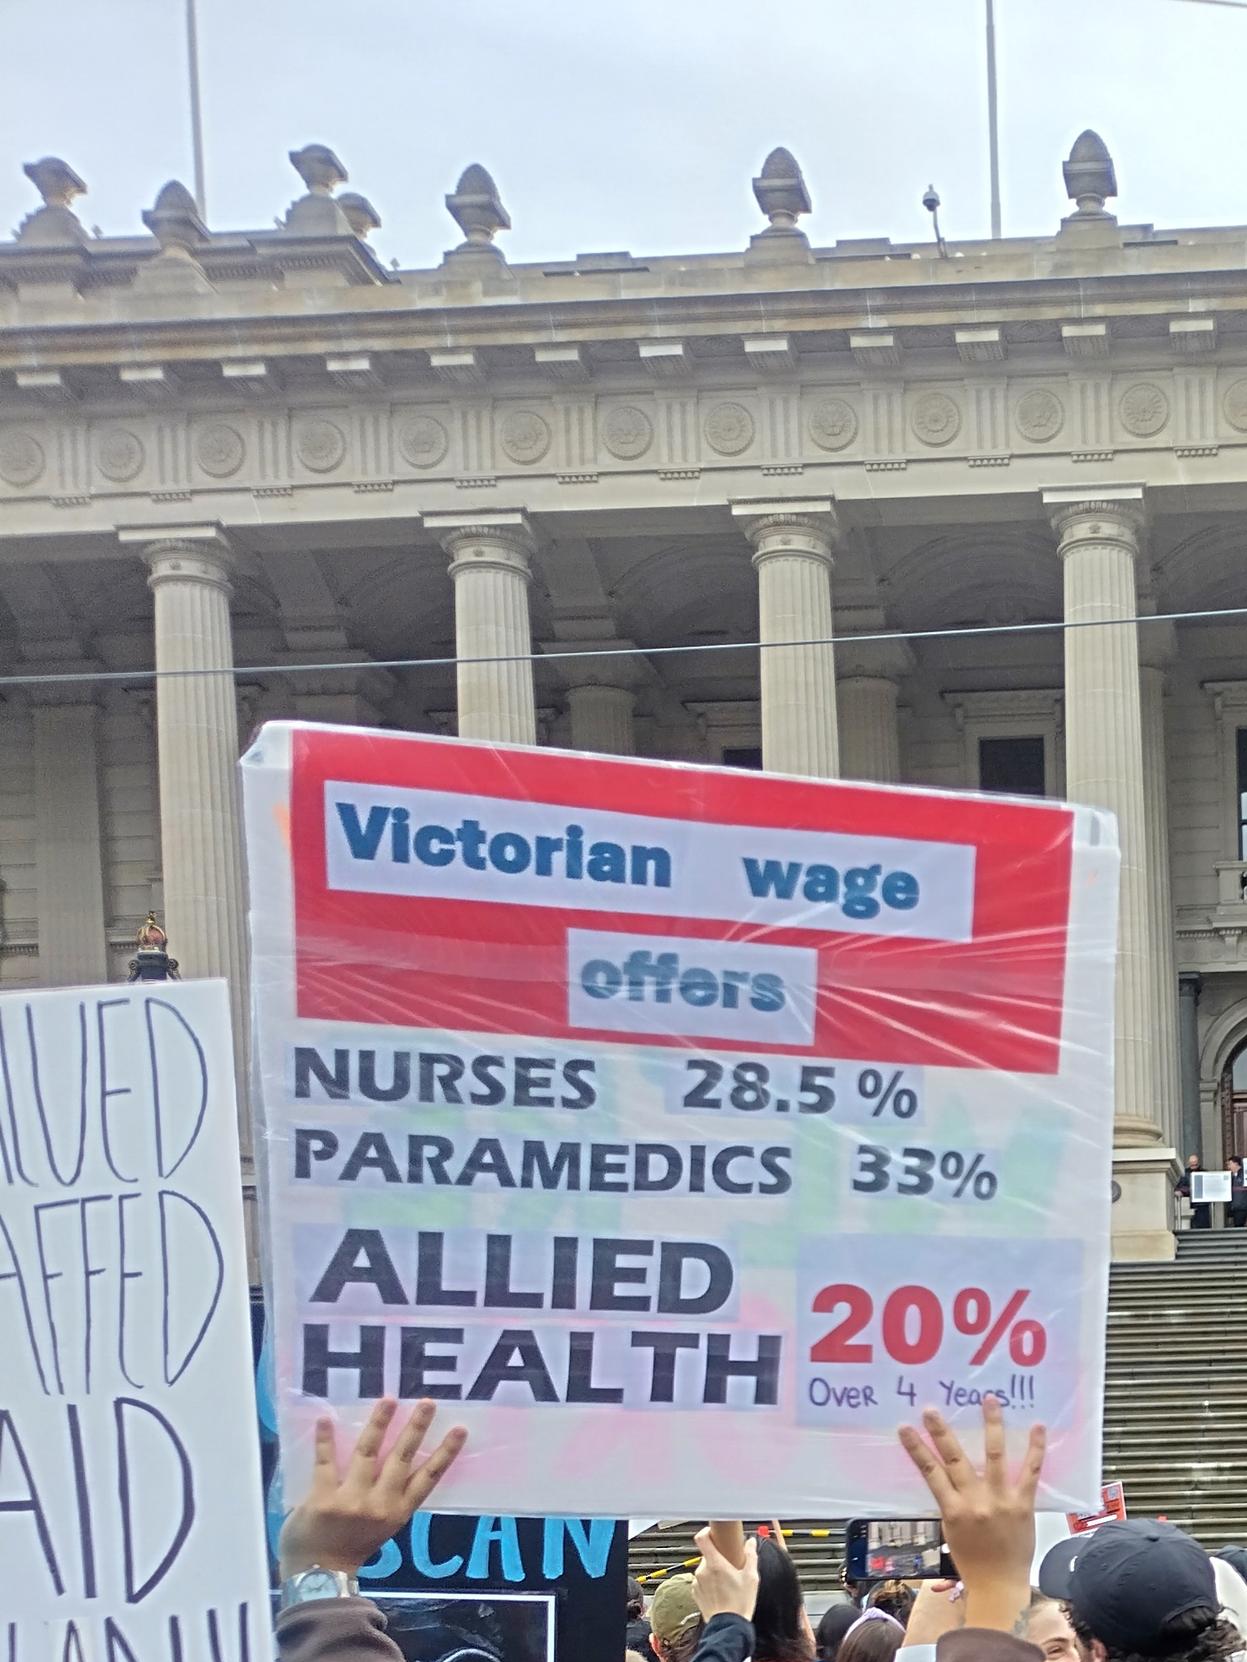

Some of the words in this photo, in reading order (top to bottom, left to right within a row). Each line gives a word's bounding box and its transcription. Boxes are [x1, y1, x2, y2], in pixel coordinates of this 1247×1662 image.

[335, 803, 672, 889] Victorian
[743, 855, 921, 920] wage
[580, 949, 787, 1014] offers
[0, 996, 208, 1188] LUED
[293, 1046, 597, 1110] NURSES
[682, 1058, 836, 1115] 28.5
[857, 1069, 918, 1120] %
[293, 1127, 793, 1196] PARAMEDICS
[851, 1146, 998, 1202] 33%
[308, 1227, 735, 1316] ALLIED
[302, 1323, 783, 1407] HEALTH
[810, 1283, 1048, 1368] 20%
[896, 1375, 917, 1407] 4
[360, 1510, 618, 1583] CAN
